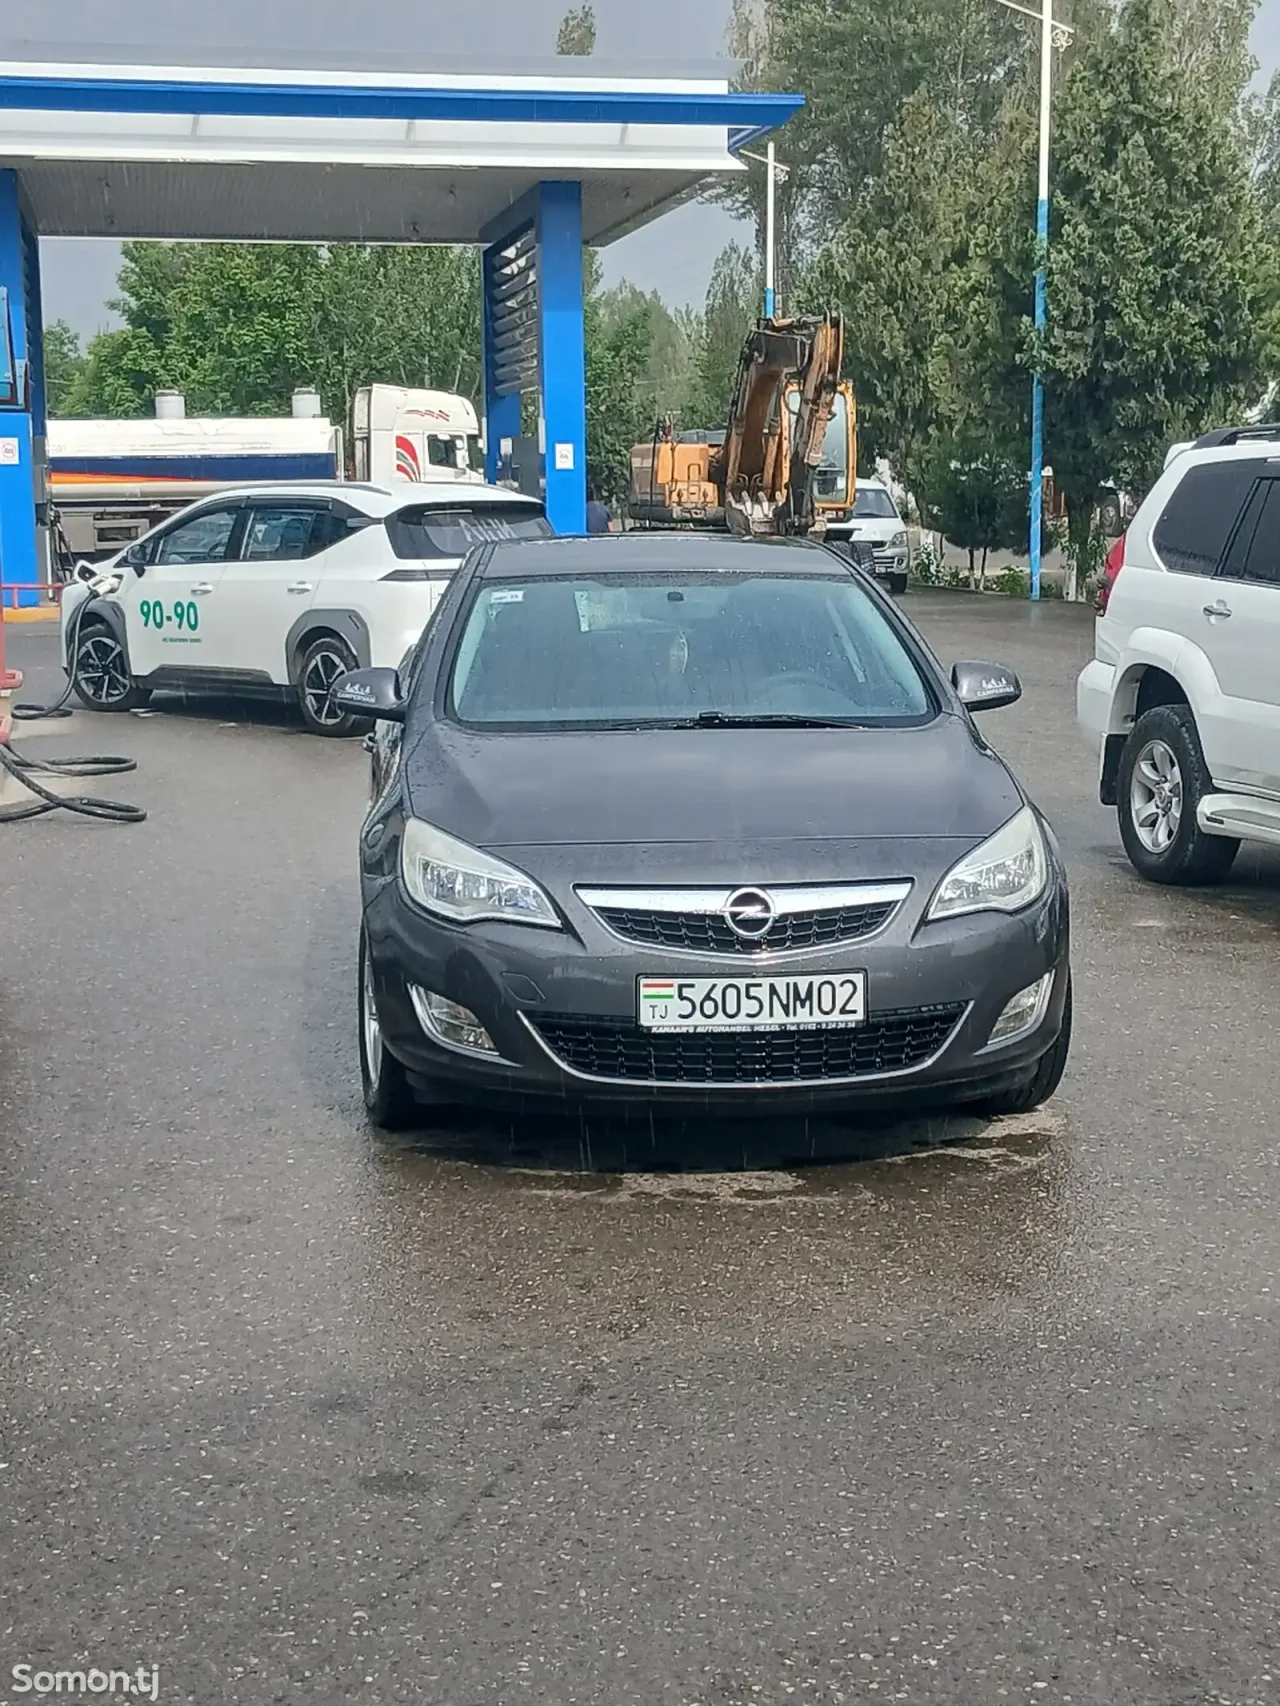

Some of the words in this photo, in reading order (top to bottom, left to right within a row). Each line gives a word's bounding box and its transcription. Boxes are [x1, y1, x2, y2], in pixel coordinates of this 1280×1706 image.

[140, 600, 199, 632] 90-90
[649, 1004, 669, 1020] TJ
[677, 980, 858, 1020] 5605NM02
